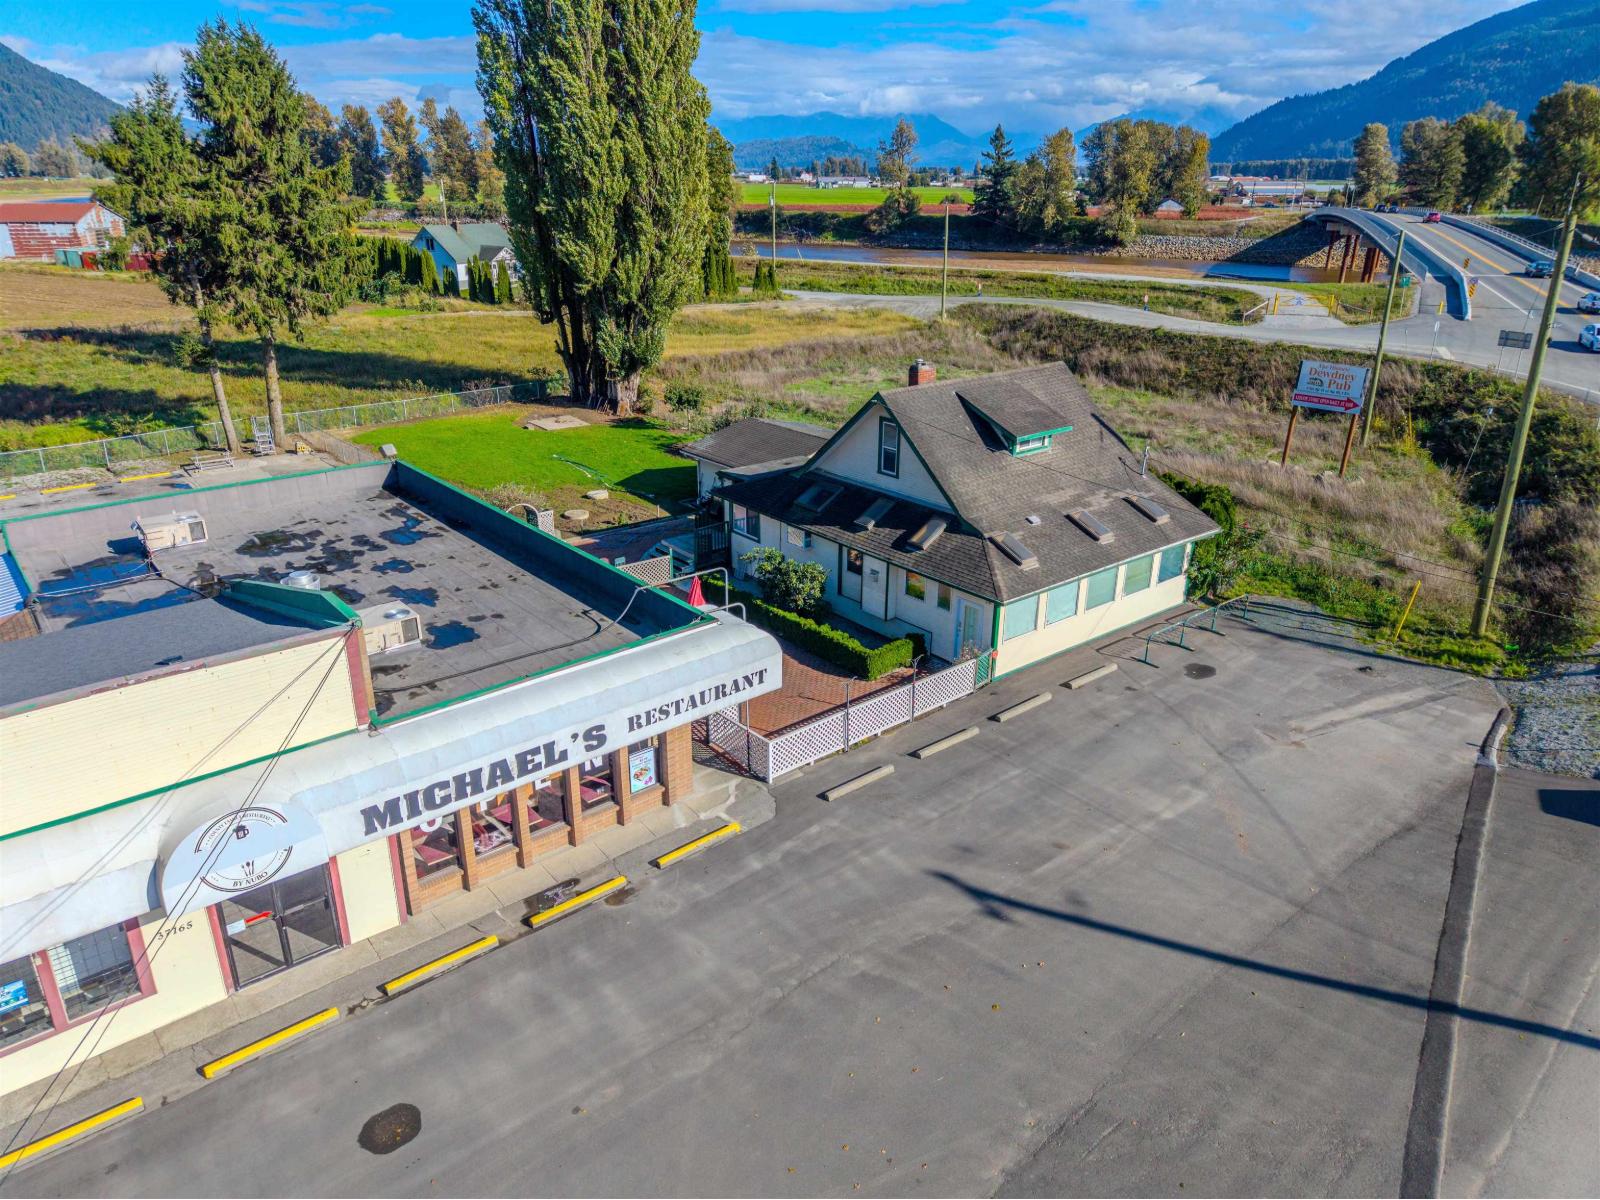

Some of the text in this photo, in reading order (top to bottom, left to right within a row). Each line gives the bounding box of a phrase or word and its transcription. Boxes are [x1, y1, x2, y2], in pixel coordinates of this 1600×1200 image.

[1309, 367, 1356, 382] Dewdney
[1327, 379, 1351, 391] Pub
[360, 668, 768, 836] MICHAEL'S RESTAURANT
[232, 871, 268, 889] BY NUBO
[157, 920, 193, 940] 37165
